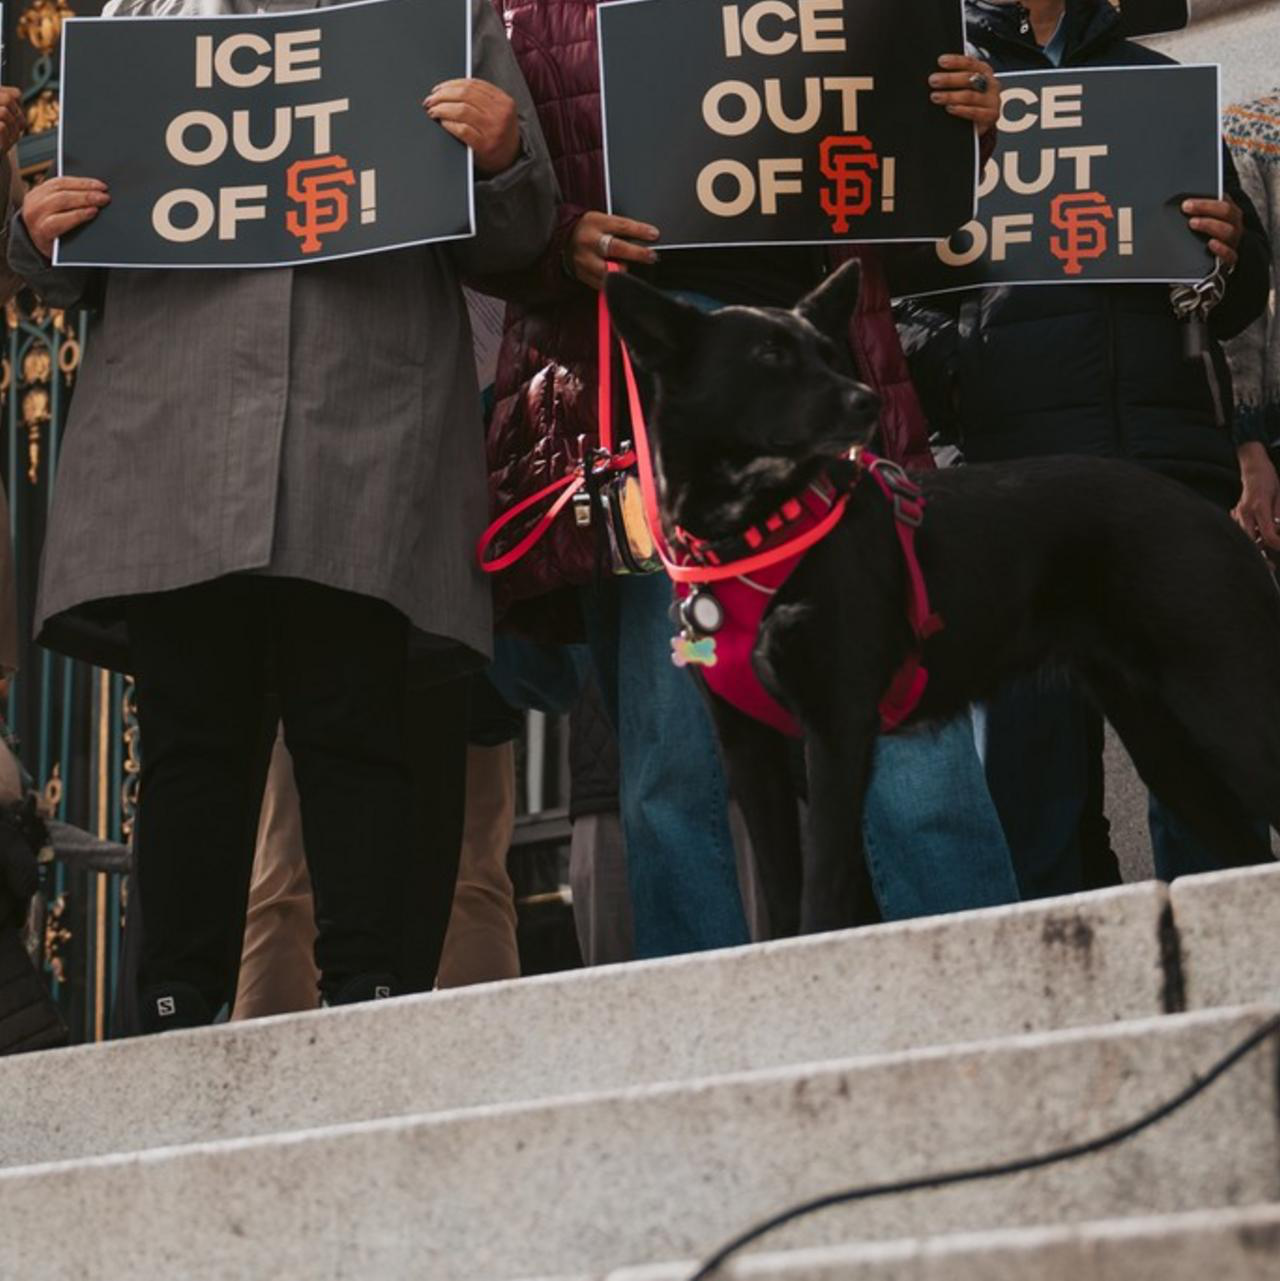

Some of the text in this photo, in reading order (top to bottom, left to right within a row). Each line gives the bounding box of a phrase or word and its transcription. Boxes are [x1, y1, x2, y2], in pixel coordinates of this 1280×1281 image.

[195, 28, 321, 88] ICE
[166, 98, 349, 166] OUT
[702, 76, 874, 136] OUT
[995, 84, 1083, 133] CE
[152, 185, 268, 242] OF
[696, 158, 803, 217] OF
[935, 213, 1034, 266] OF
